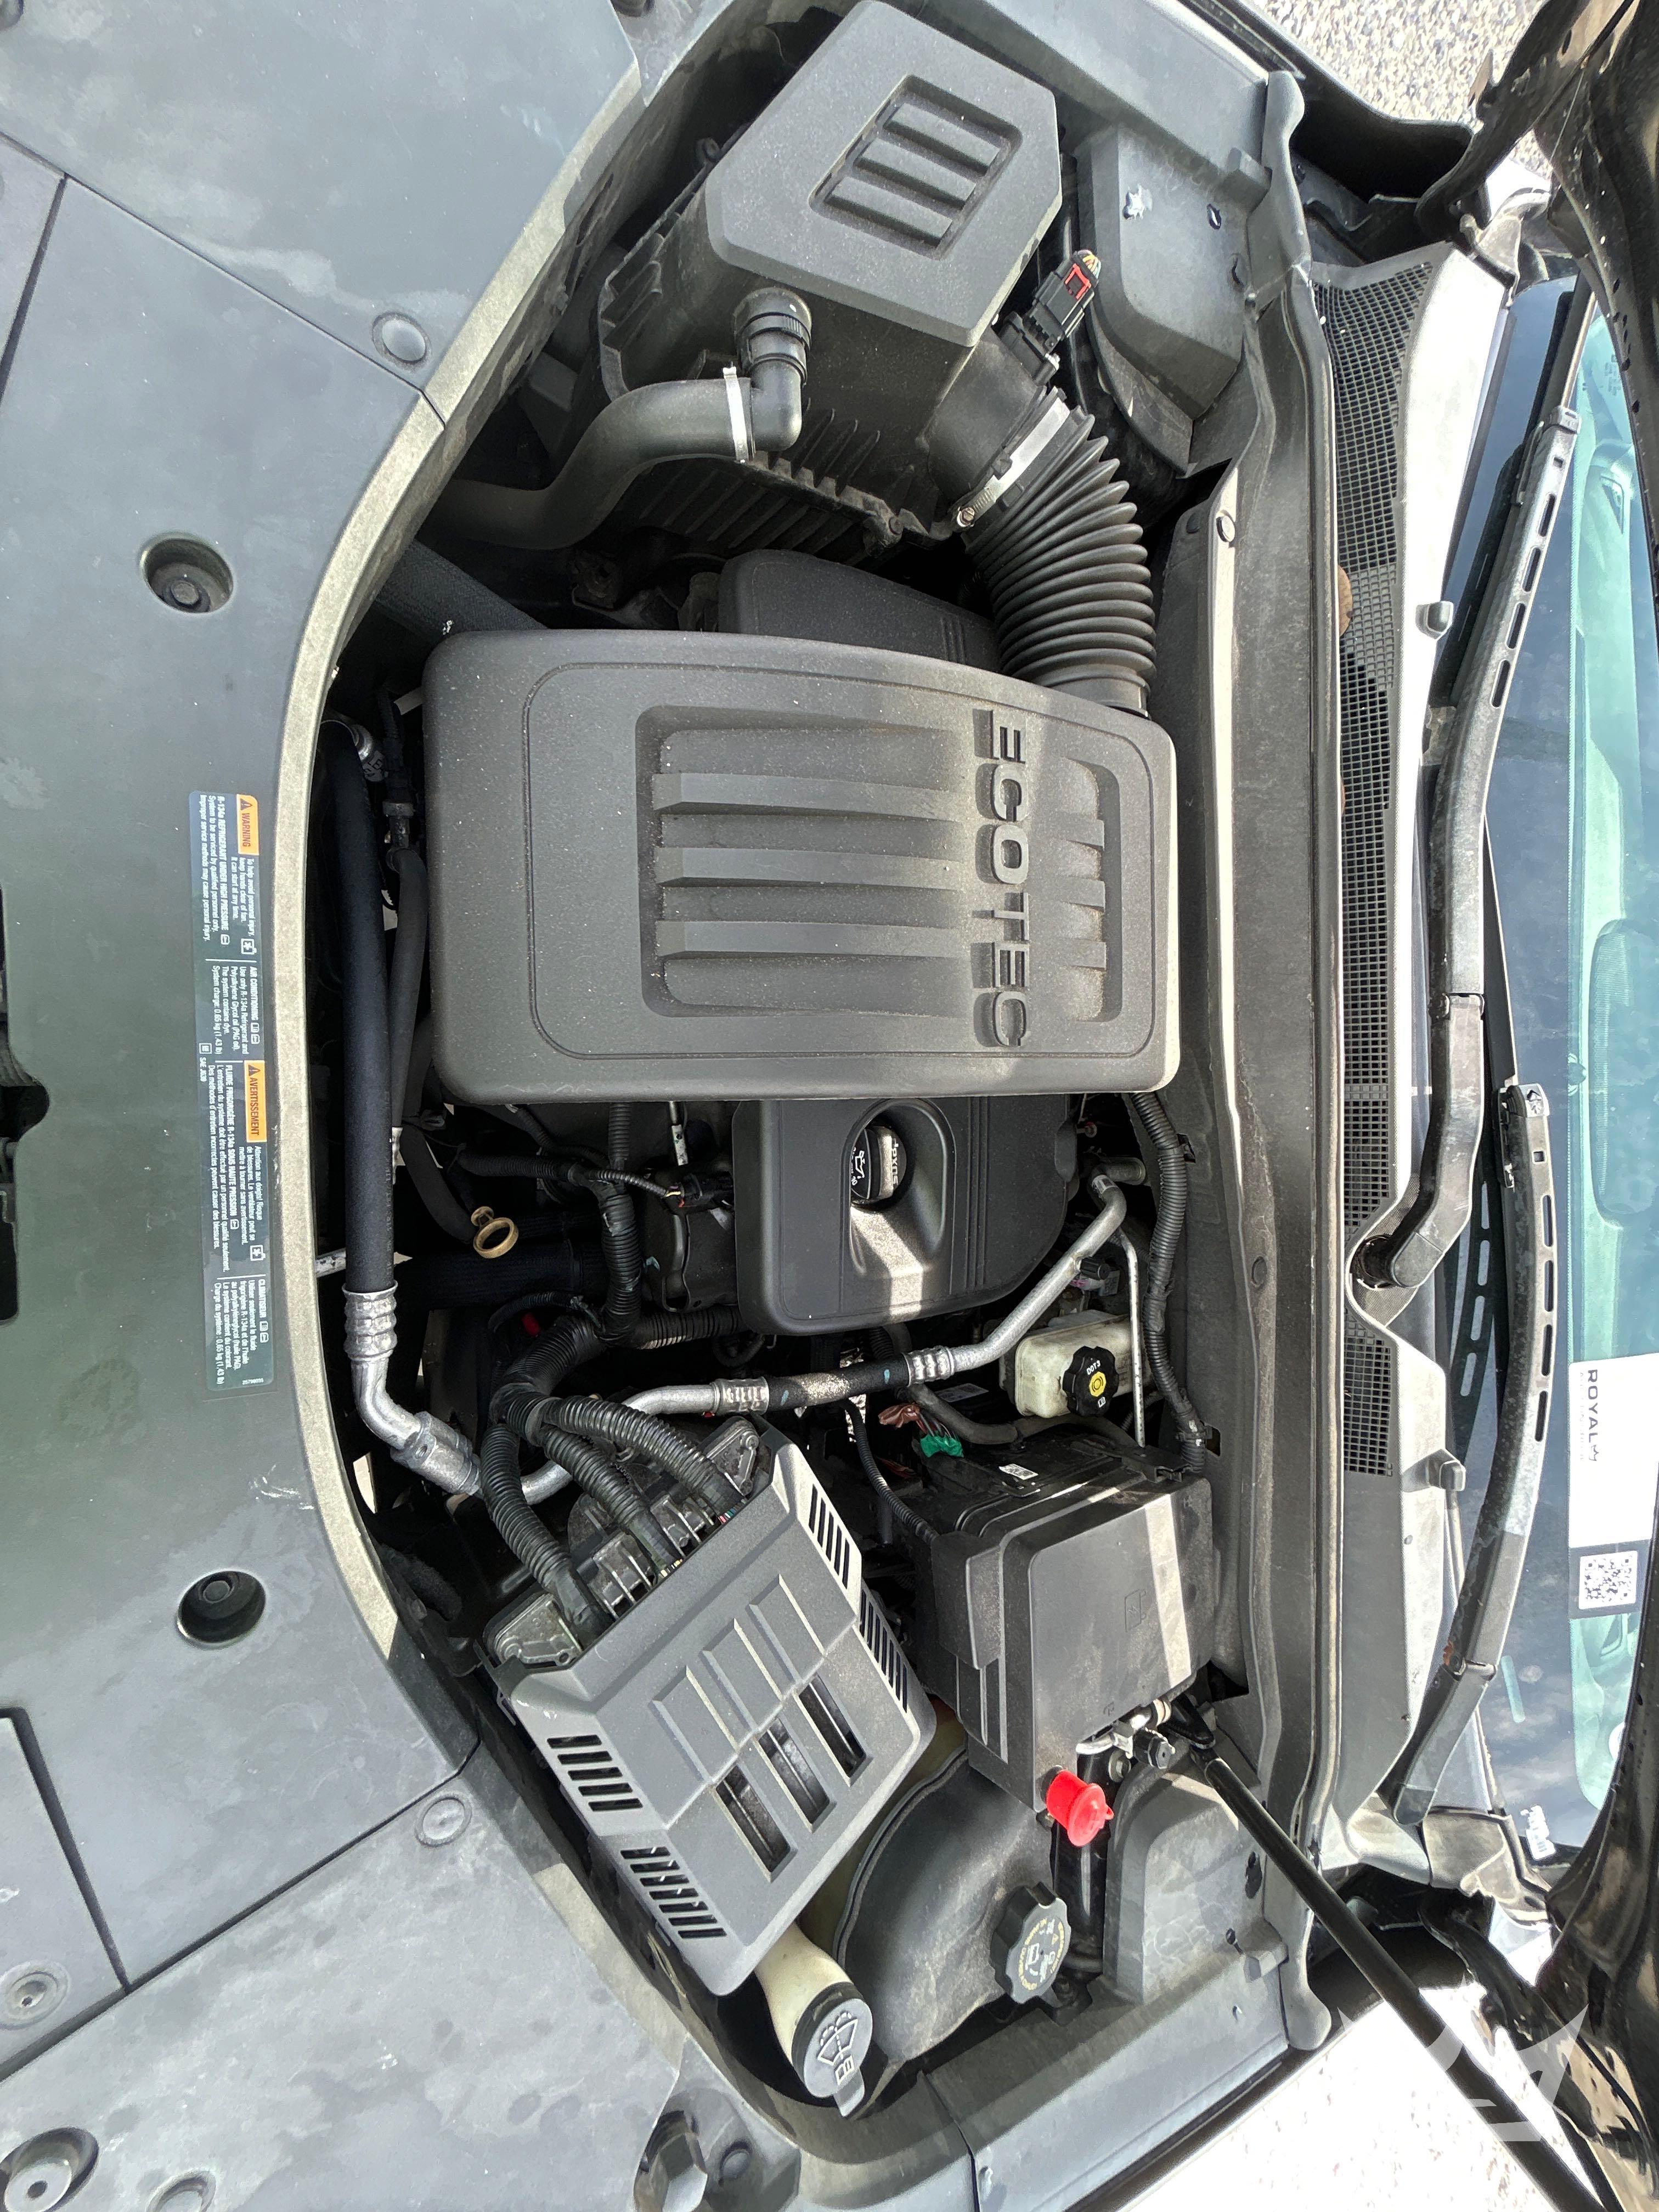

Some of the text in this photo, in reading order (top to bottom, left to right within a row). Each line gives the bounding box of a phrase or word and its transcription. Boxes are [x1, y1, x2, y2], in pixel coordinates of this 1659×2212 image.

[207, 795, 216, 816] System
[218, 819, 227, 861] REFRIGERANT
[242, 813, 251, 847] WARNING
[210, 866, 218, 890] qualified
[246, 866, 255, 878] help
[991, 709, 1030, 1047] ECOTEC
[202, 900, 211, 923] personal
[211, 891, 219, 918] personnel
[247, 895, 255, 918] personal
[203, 924, 211, 941] injury.
[211, 919, 219, 932] only.
[212, 966, 221, 986] System
[230, 966, 238, 1000] Polyalkylene
[230, 1001, 239, 1018] Glycol
[250, 978, 258, 1020] CONDITIONING
[214, 1031, 222, 1046] (1.43
[232, 1027, 240, 1040] (PAG
[240, 1013, 249, 1042] Refrigerant
[232, 1041, 240, 1051] oil).
[208, 1077, 217, 1104] méthodes
[217, 1065, 225, 1093] L'entretien
[217, 1103, 226, 1126] système
[226, 1087, 235, 1125] FRIGORIGÈNE
[250, 1077, 259, 1135] AVERTISSEMENT
[227, 1127, 235, 1148] R-134a
[891, 1138, 899, 1185] dexos
[210, 1167, 218, 1189] peuvent
[229, 1186, 237, 1216] PRESSION
[255, 1182, 263, 1200] doigts!
[220, 1194, 228, 1220] personnel
[221, 1221, 229, 1241] qualifié
[213, 1283, 222, 1302] Charge
[222, 1290, 230, 1313] système
[239, 1280, 247, 1310] frigorigène
[214, 1312, 223, 1335] système
[216, 1362, 224, 1376] (1.43
[233, 1356, 241, 1370] PAG).
[1086, 1362, 1097, 1375] DOT
[1588, 1369, 1598, 1443] ROYAL
